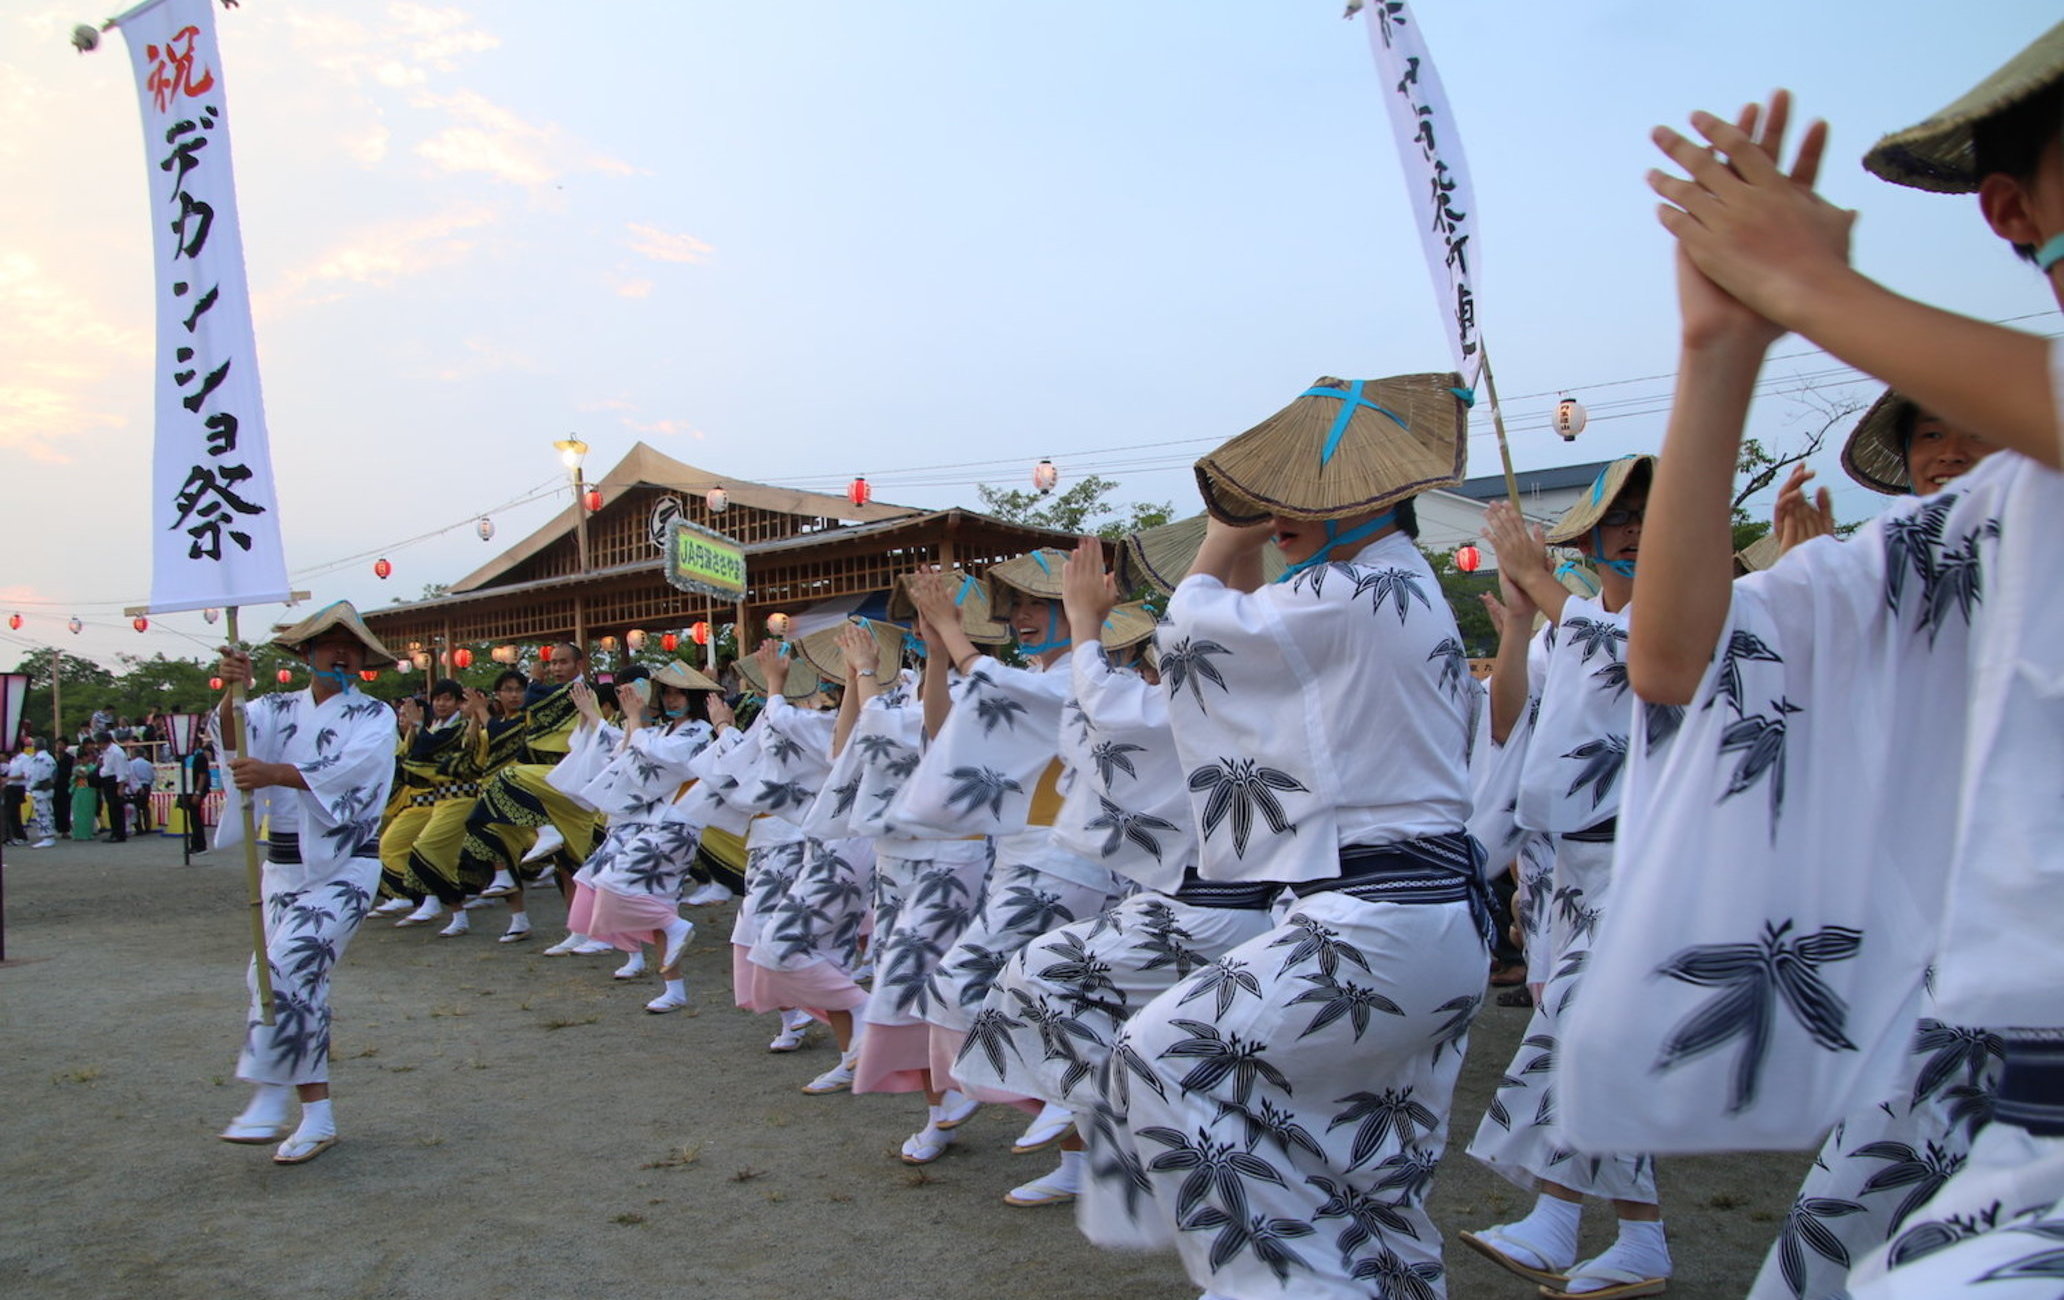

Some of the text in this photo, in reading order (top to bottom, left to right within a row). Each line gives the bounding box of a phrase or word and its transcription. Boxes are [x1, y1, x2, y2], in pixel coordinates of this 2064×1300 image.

[680, 540, 740, 580] JA丹波ささやま
